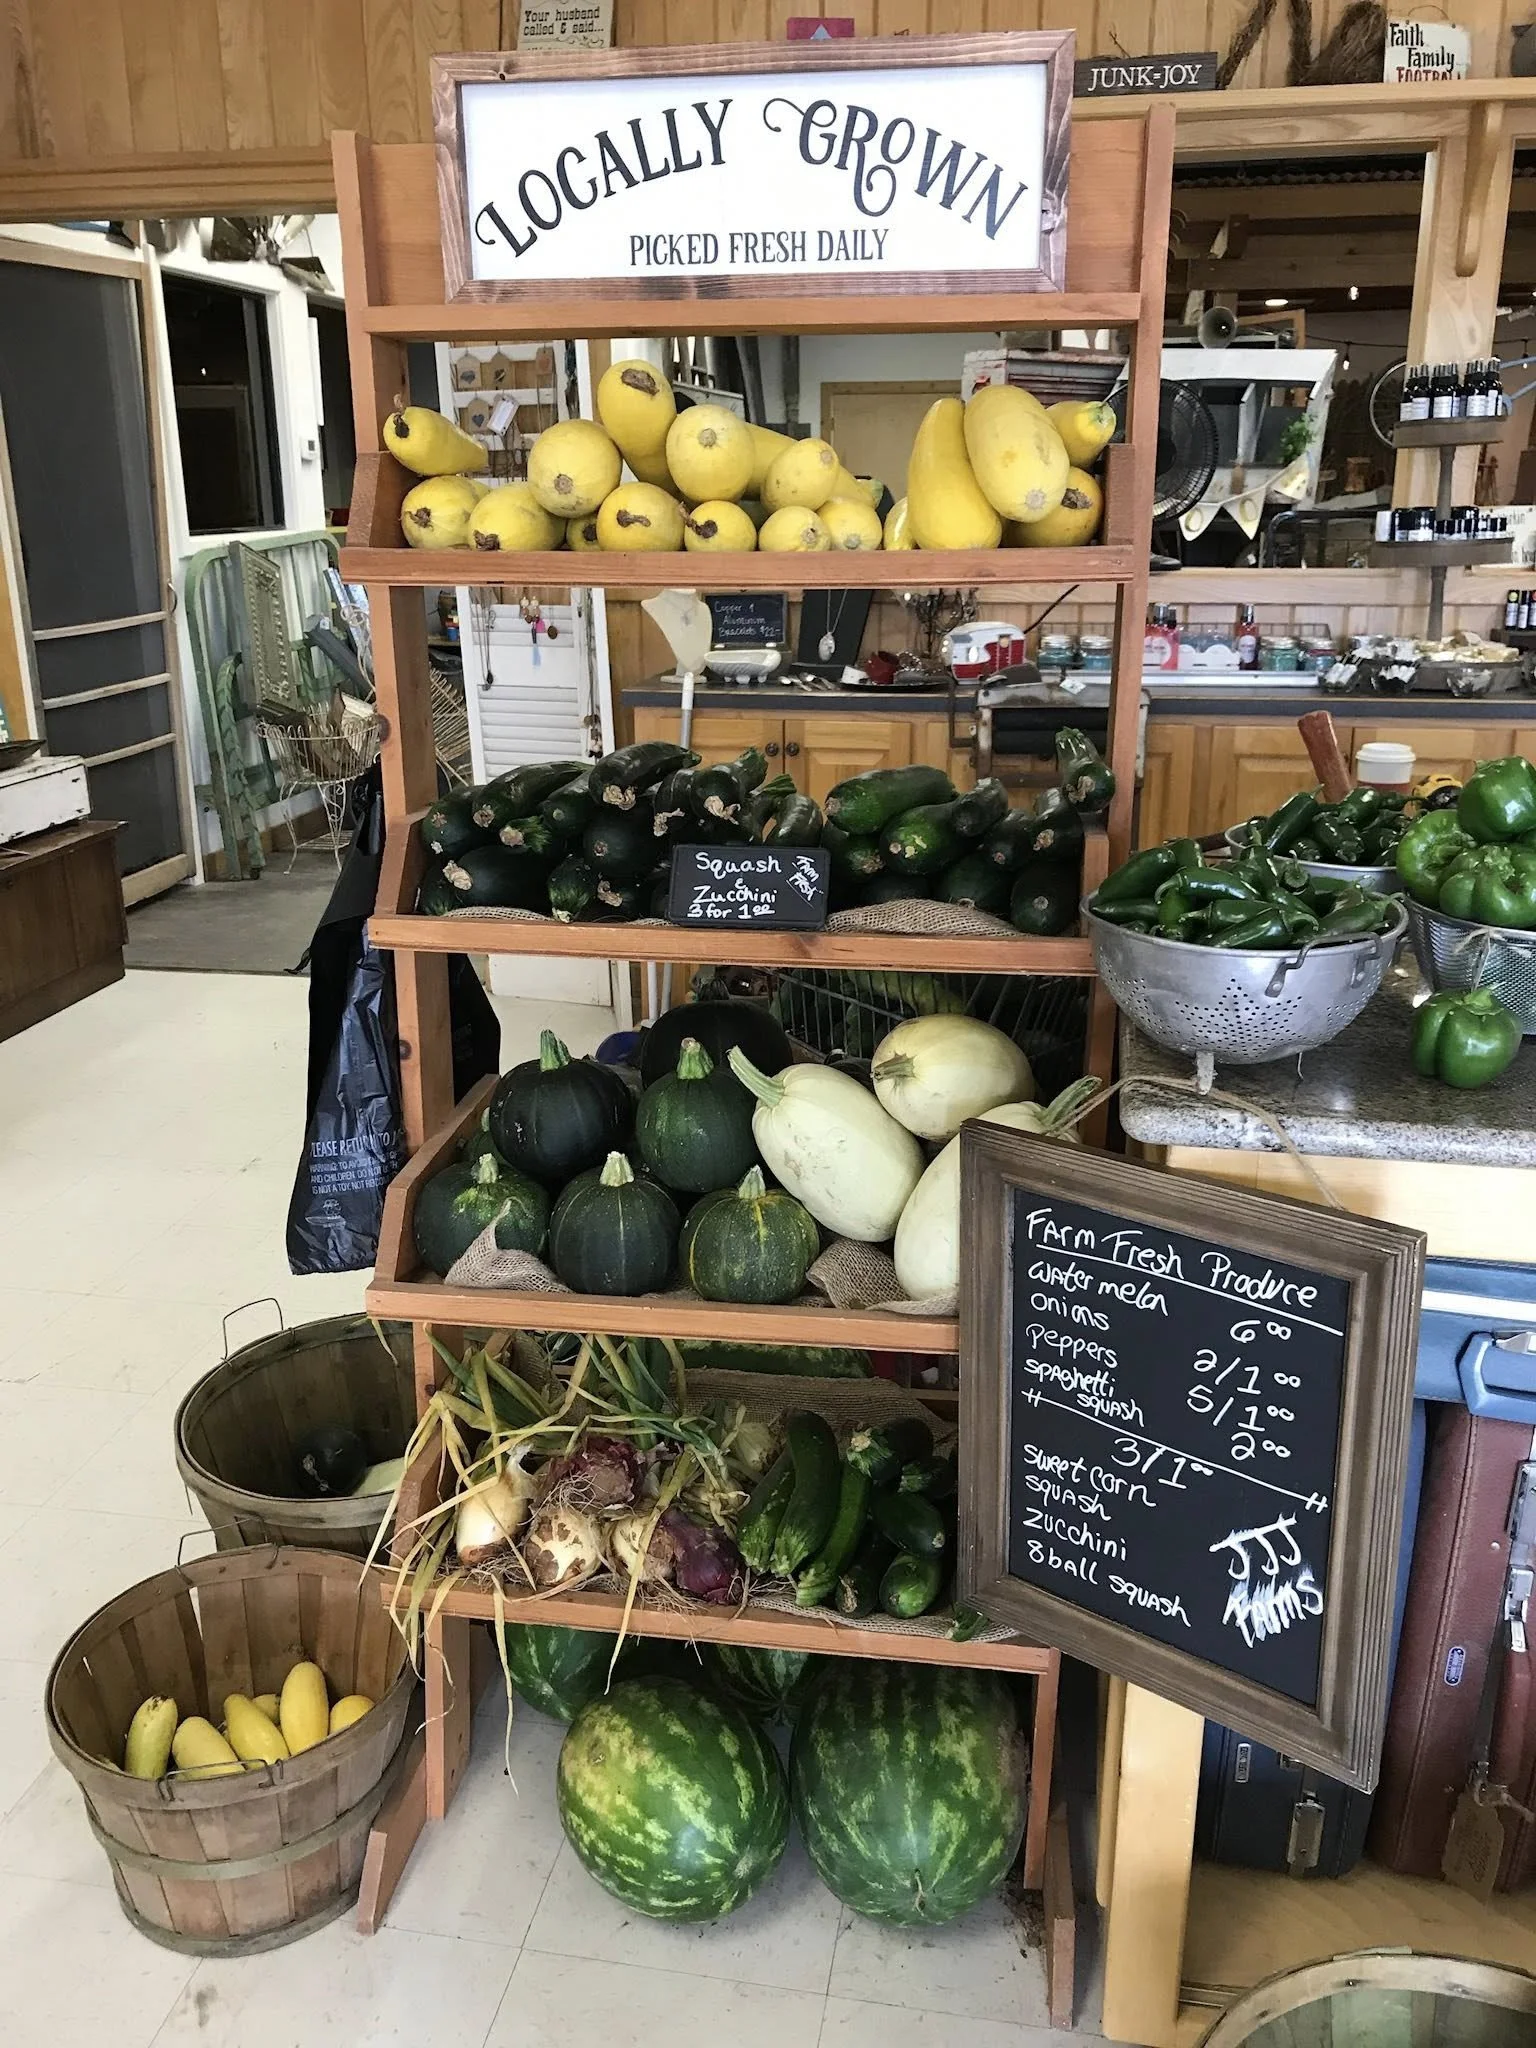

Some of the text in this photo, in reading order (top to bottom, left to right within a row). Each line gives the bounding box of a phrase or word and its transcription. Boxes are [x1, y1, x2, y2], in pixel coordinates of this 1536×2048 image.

[525, 6, 600, 22] Your husband
[523, 22, 554, 36] called
[1389, 22, 1424, 47] Faith
[1407, 45, 1455, 74] Family
[475, 98, 1029, 258] LOCALLY GROWN
[629, 228, 889, 266] PICKED FRESH DAILY
[695, 851, 782, 880] Squash
[693, 886, 778, 904] Zucchini
[687, 903, 703, 918] 3
[706, 903, 732, 918] for
[1101, 1230, 1184, 1280] Fresh
[1200, 1251, 1318, 1308] Produce
